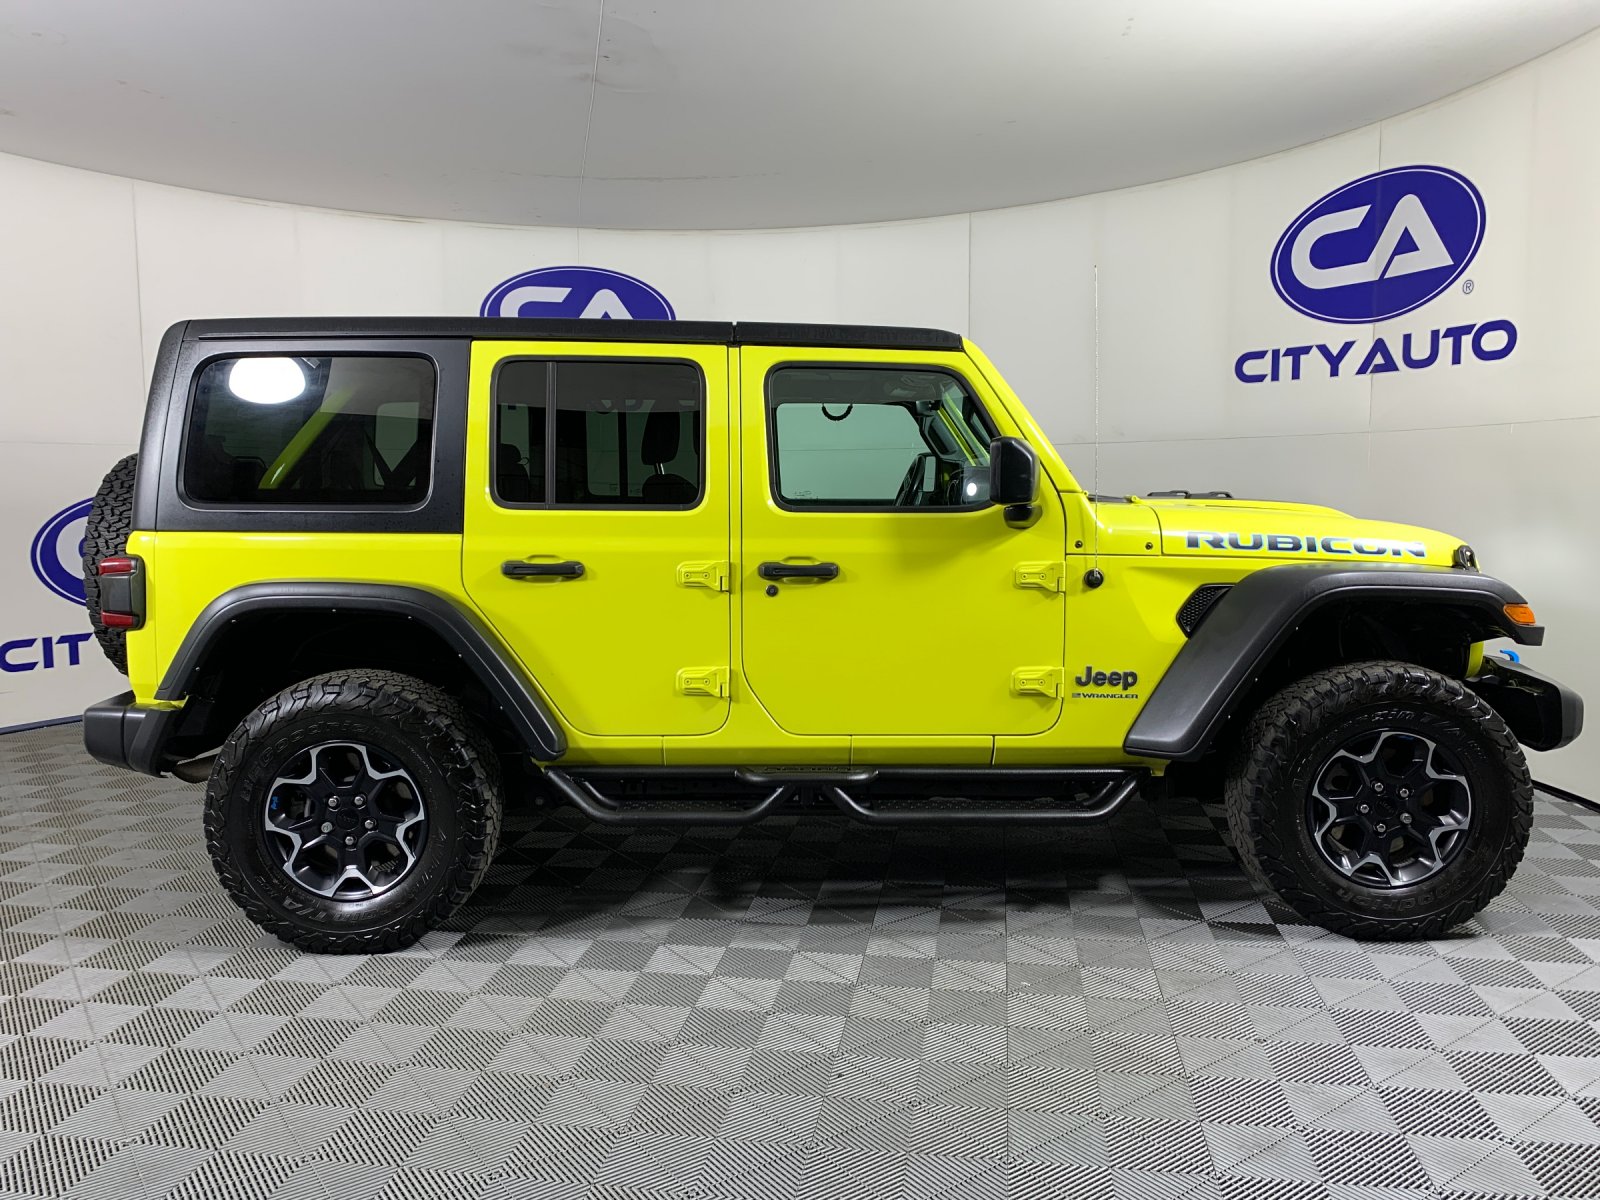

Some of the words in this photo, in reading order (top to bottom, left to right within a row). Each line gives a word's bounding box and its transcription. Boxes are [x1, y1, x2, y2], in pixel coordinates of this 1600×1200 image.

[1290, 193, 1455, 290] CA
[1234, 340, 1356, 384] CITY
[1355, 319, 1518, 376] AUTO
[1185, 530, 1427, 559] RUBICON
[0, 632, 94, 673] CIT
[1075, 665, 1138, 691] Jeep
